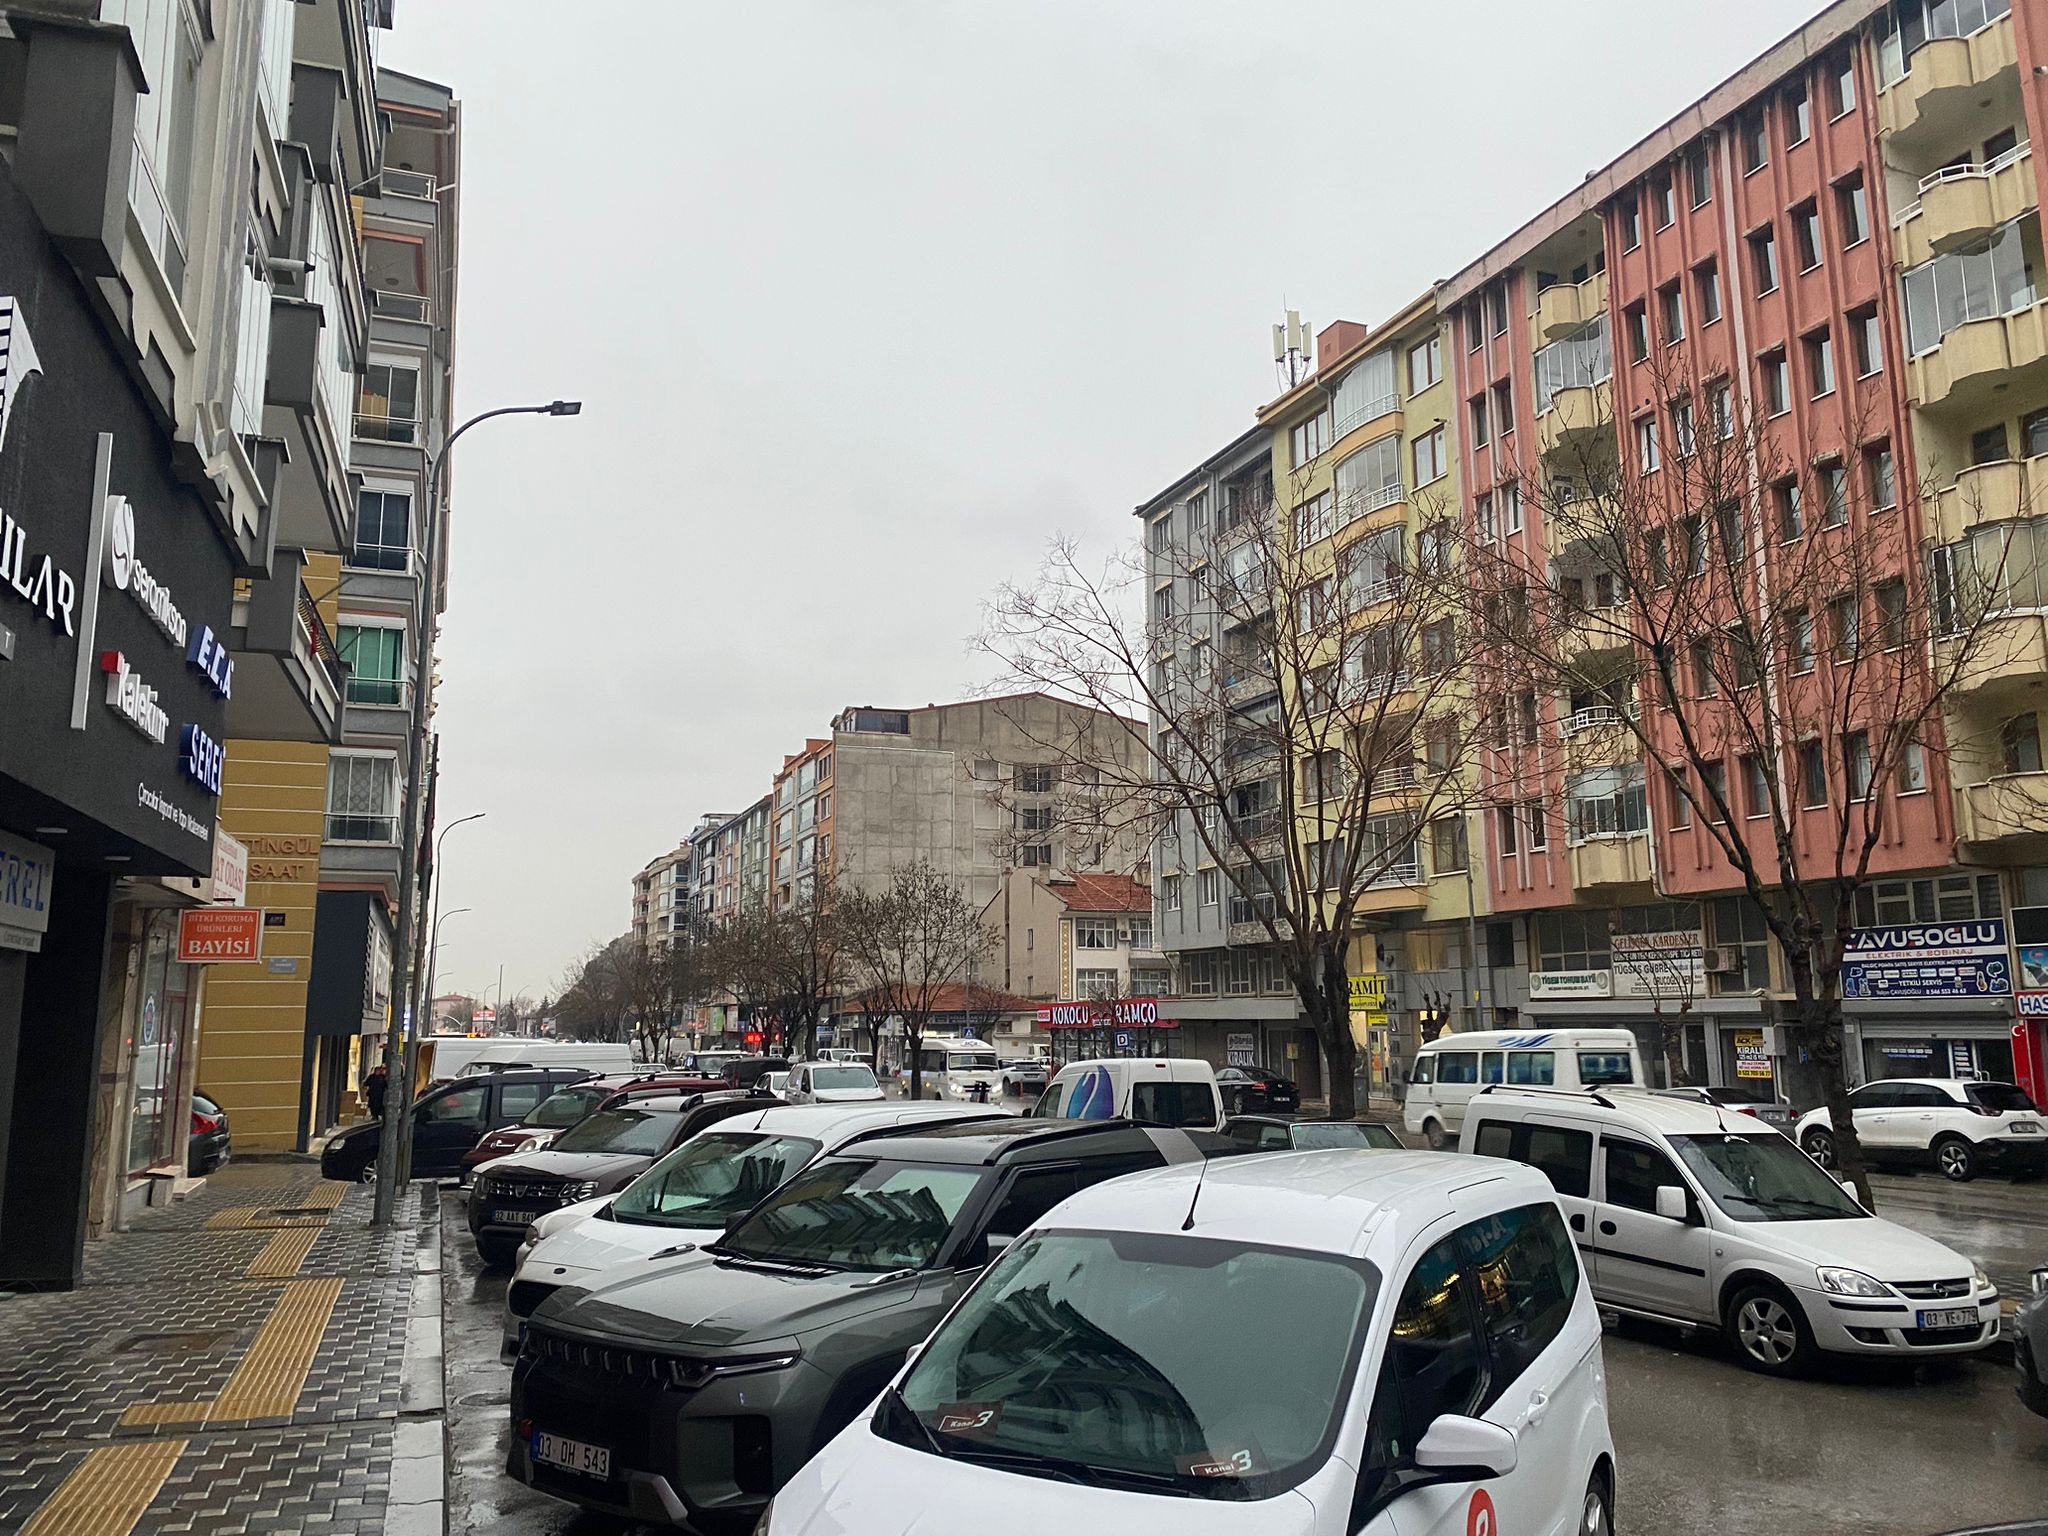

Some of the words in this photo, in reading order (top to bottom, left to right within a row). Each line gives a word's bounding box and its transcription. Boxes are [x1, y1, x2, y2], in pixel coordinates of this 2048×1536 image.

[0, 508, 74, 637] ILAR
[189, 913, 214, 923] BİTKİ
[215, 914, 254, 923] KORUMA
[196, 925, 242, 933] ÜRÜNLERİ
[189, 937, 250, 954] BAYİSİ
[1118, 1034, 1127, 1046] D
[1926, 1312, 1938, 1326] 03
[950, 1419, 975, 1428] Kanal
[972, 1410, 994, 1428] 3
[539, 1434, 552, 1458] 03
[561, 1440, 576, 1465] DH
[583, 1446, 607, 1474] 543
[1204, 1462, 1235, 1475] Kanal
[1231, 1449, 1252, 1472] 3
